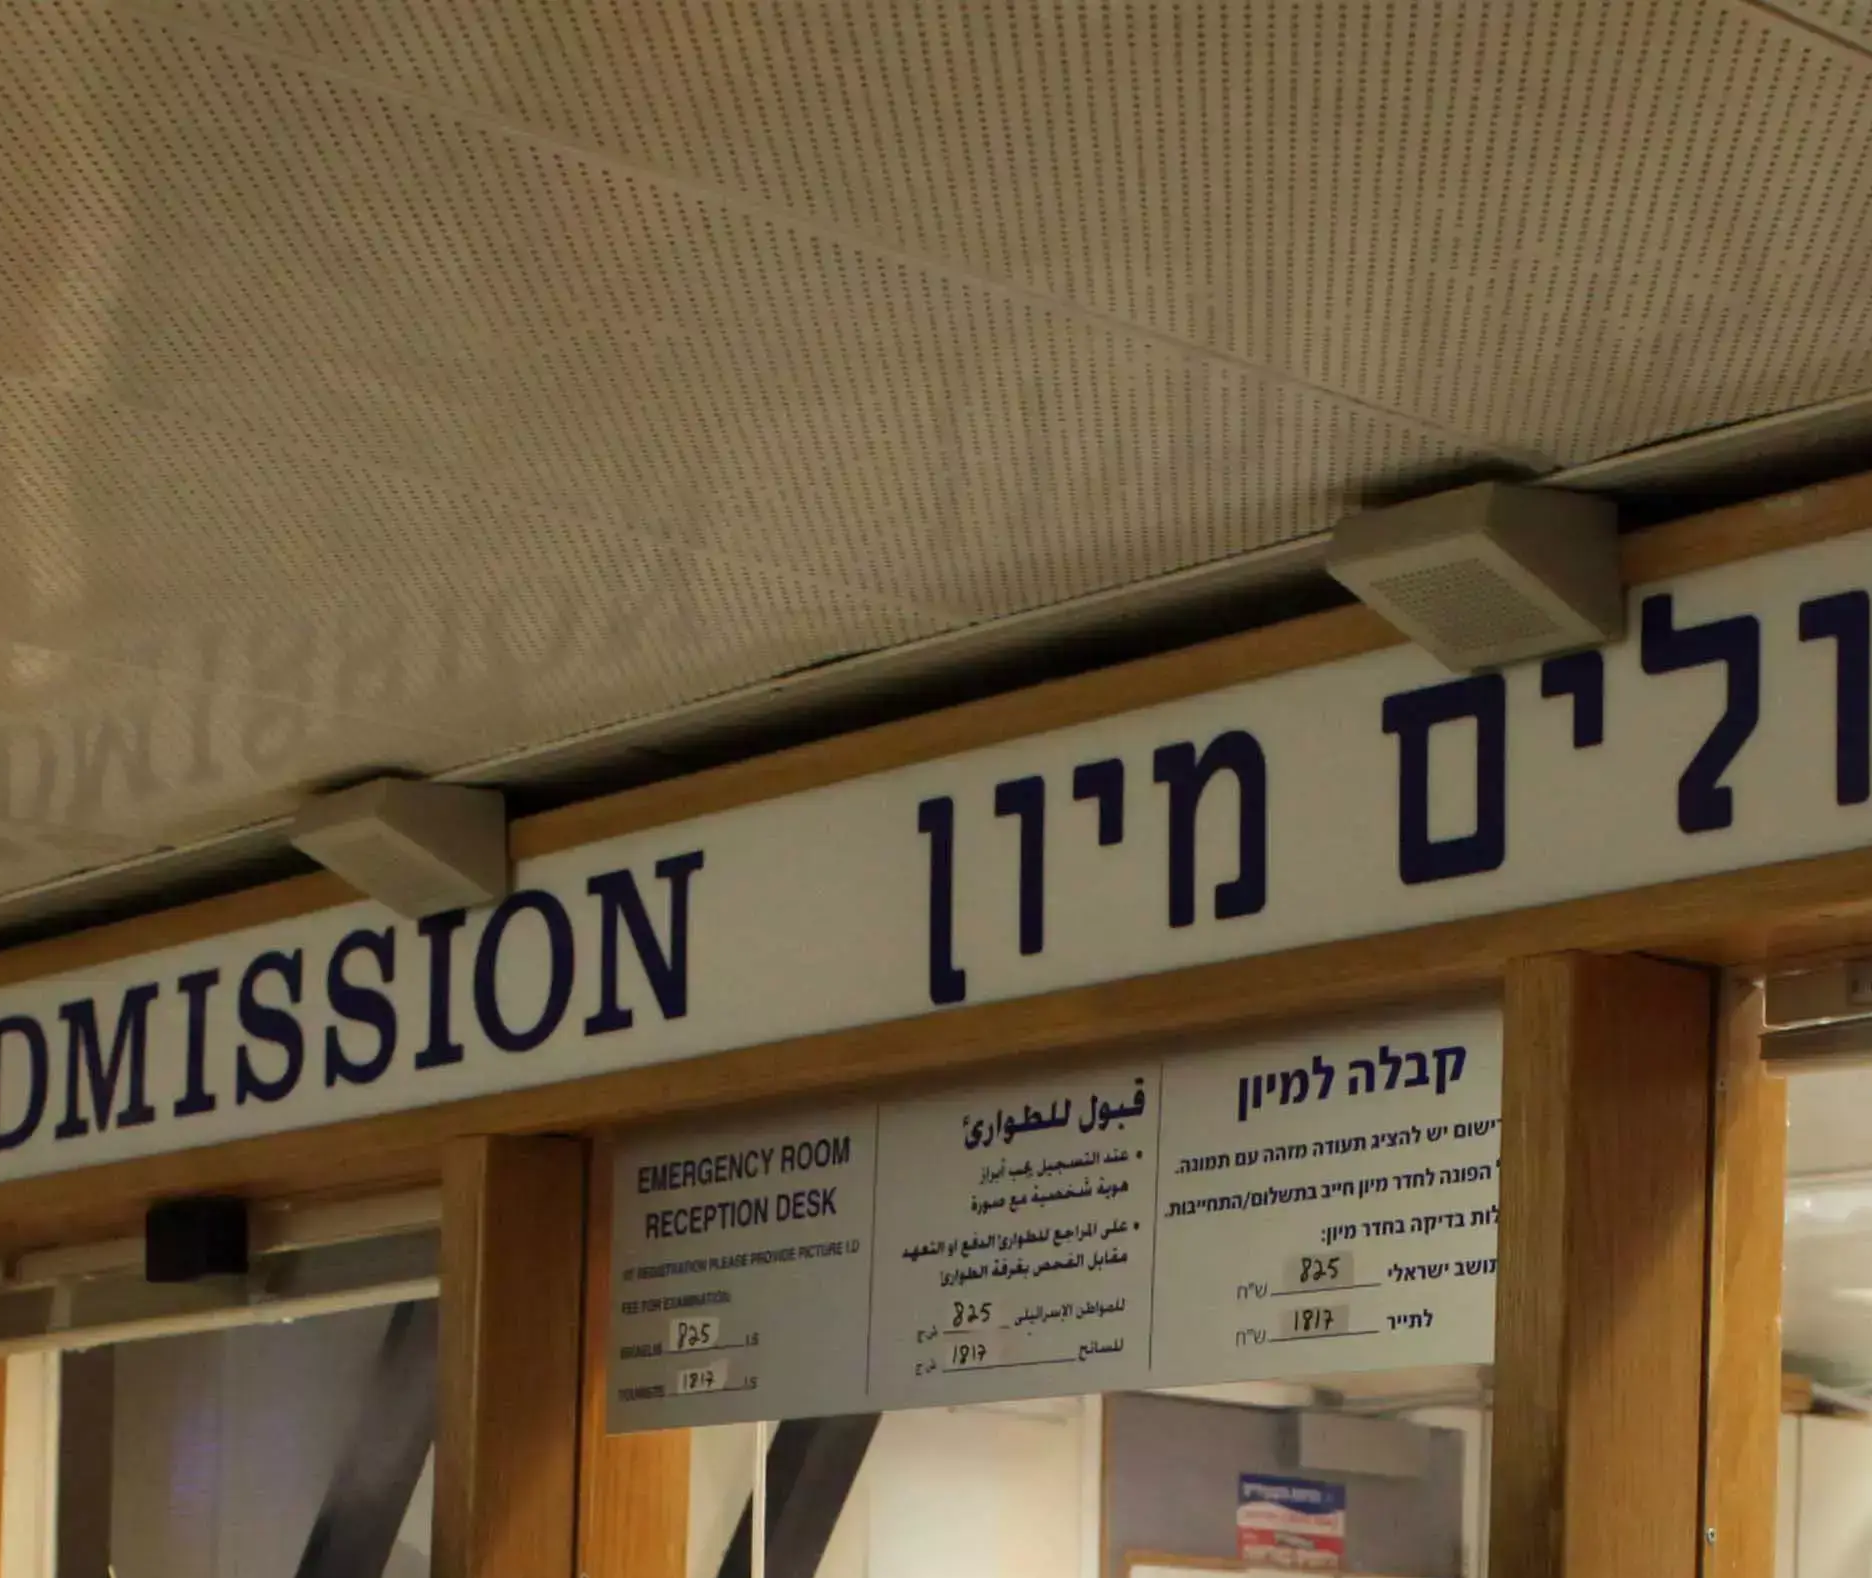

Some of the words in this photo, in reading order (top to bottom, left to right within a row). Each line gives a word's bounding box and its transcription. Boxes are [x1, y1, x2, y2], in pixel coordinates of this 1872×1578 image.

[917, 729, 1267, 1005] מיון
[1348, 1045, 1467, 1095] קבלה
[1238, 1055, 1334, 1122] למיון
[1078, 1076, 1147, 1134] قبول
[1371, 1125, 1421, 1149] להציג
[1427, 1125, 1448, 1142] יש
[1263, 1144, 1307, 1162] מזהה
[1312, 1136, 1366, 1157] תעודה
[637, 1147, 774, 1194] EMERGENCY
[780, 1136, 851, 1173] ROOM
[1175, 1154, 1230, 1174] תמונה.
[1235, 1150, 1259, 1166] עם
[1393, 1168, 1435, 1190] לחדר
[1440, 1165, 1491, 1184] הפונה
[1321, 1181, 1354, 1198] חייב
[1358, 1177, 1388, 1199] מיון
[646, 1197, 768, 1239] RECEPTION
[776, 1187, 837, 1222] DESK
[1471, 1205, 1500, 1226] לות
[1362, 1219, 1404, 1236] בחדר
[1410, 1213, 1464, 1235] בדיקה
[1321, 1225, 1356, 1245] מיון:
[1300, 1256, 1341, 1283] 825
[1387, 1263, 1449, 1282] ישראלי
[952, 1302, 992, 1327] 825
[1294, 1309, 1334, 1331] 1817
[1387, 1309, 1433, 1330] לתייר
[952, 1344, 987, 1365] 1817
